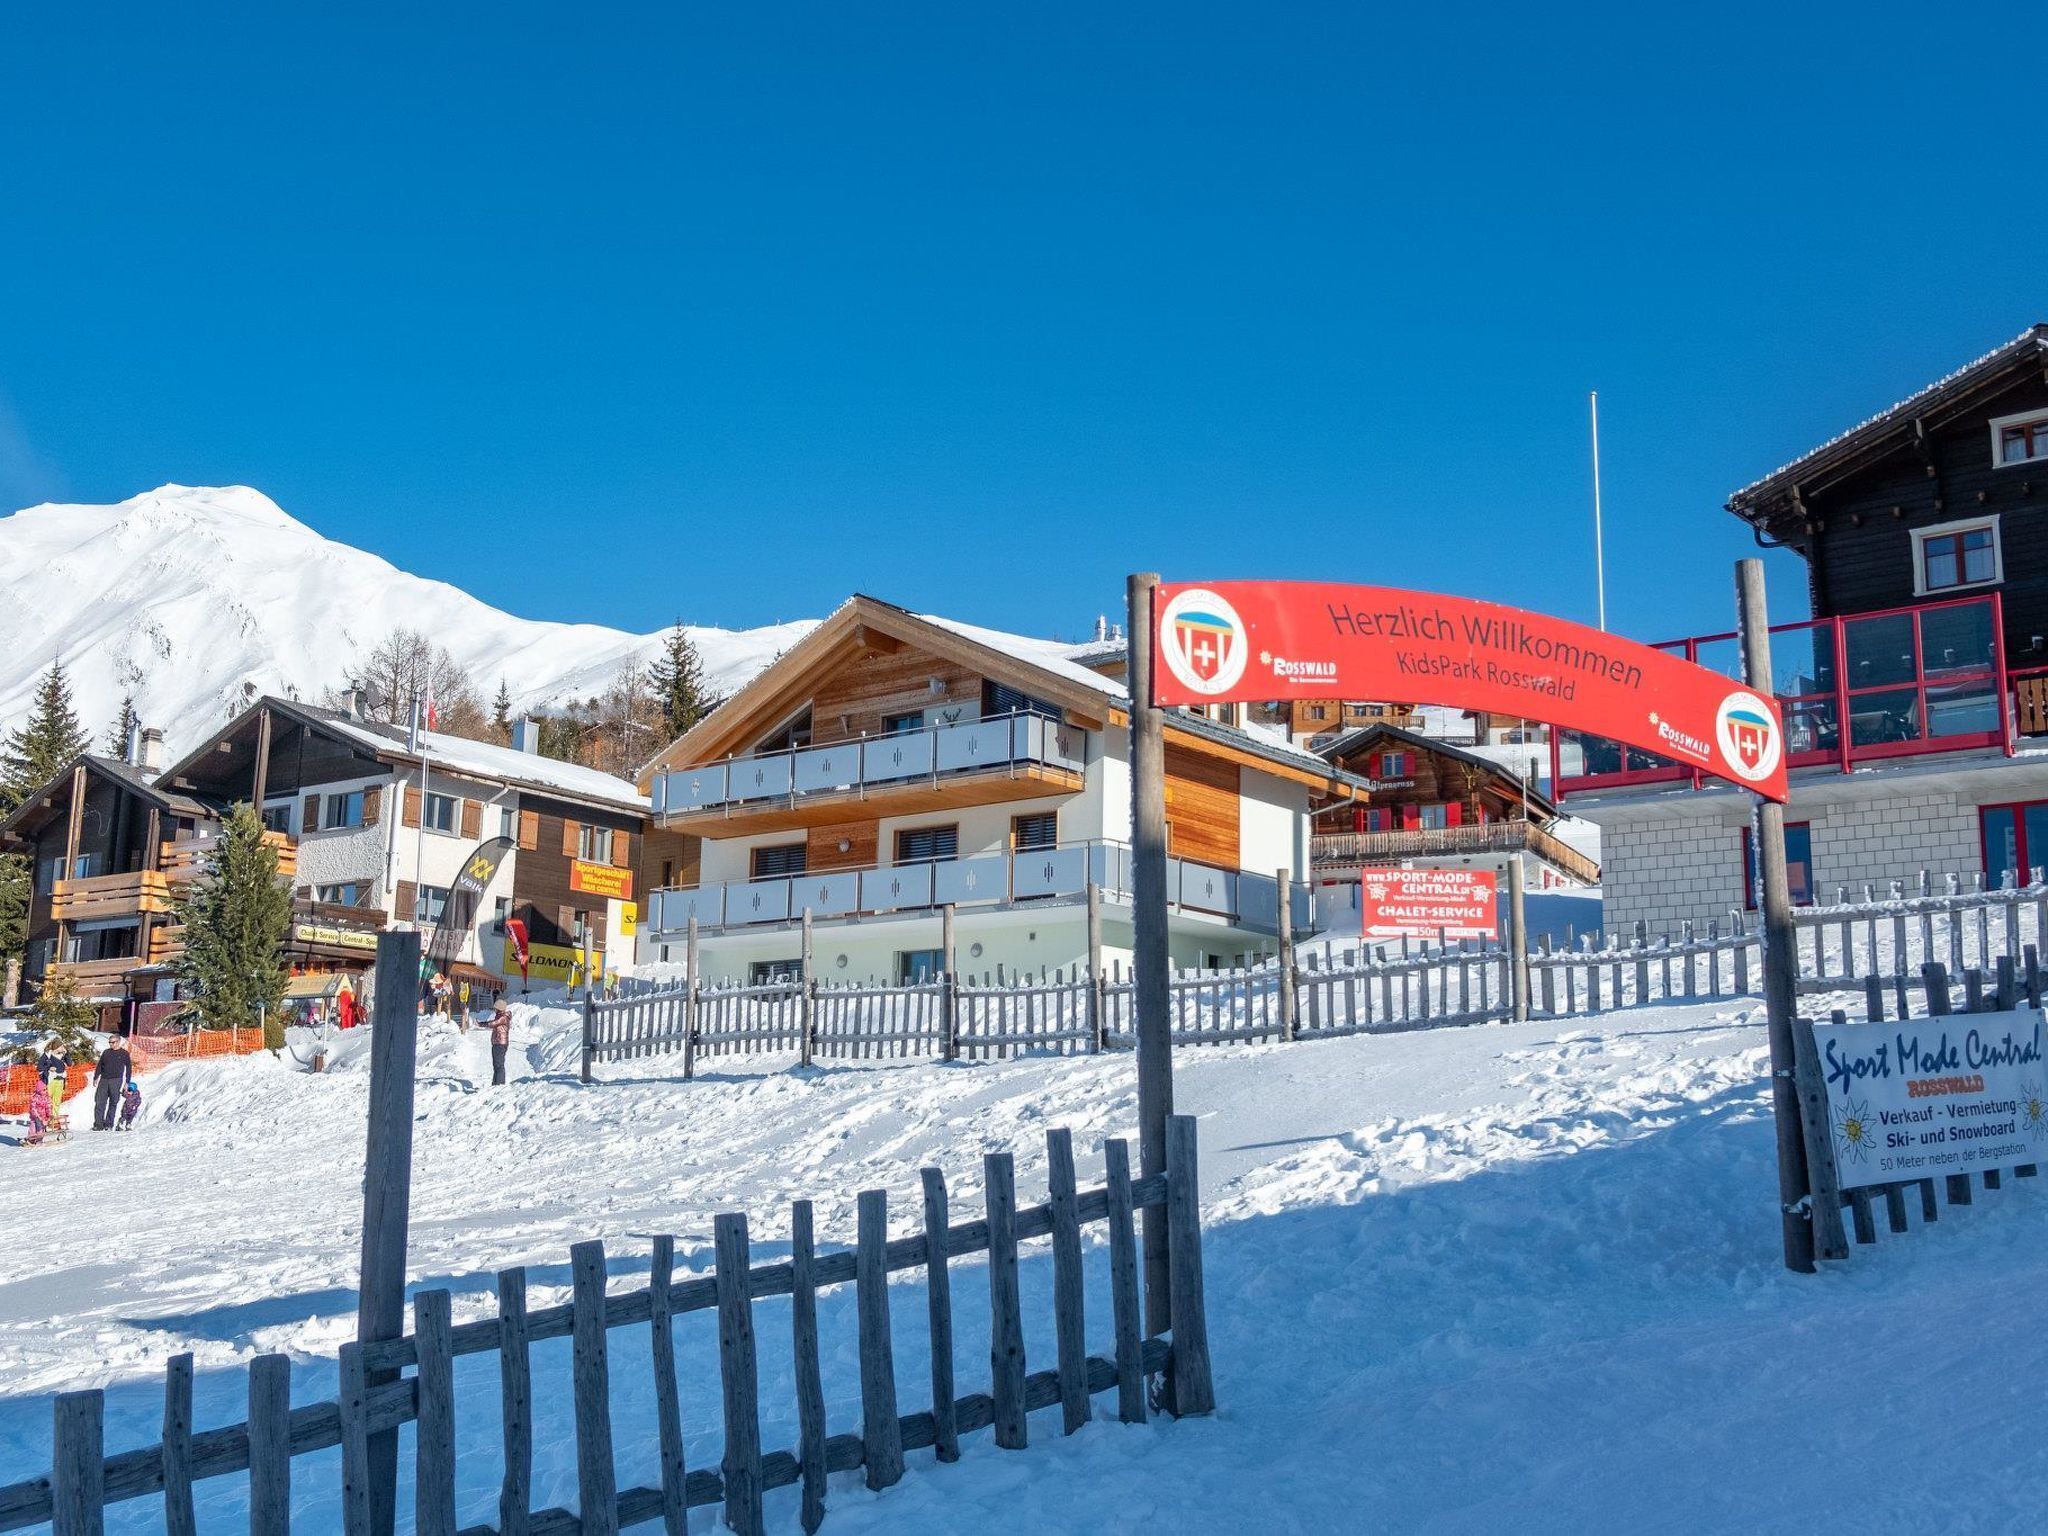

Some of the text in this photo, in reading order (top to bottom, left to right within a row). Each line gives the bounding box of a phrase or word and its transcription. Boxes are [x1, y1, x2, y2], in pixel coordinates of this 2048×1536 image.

[1327, 604, 1642, 690] Herzlich Willkommen
[1273, 657, 1337, 676] ROSSWALD
[1397, 651, 1576, 701] KidsPark Rosswald
[1658, 721, 1710, 755] ROSSWALD
[1376, 905, 1484, 918] CHALET-SERVICE
[509, 952, 579, 969] SLOMON
[1825, 1023, 2042, 1095] Sport Mode Central
[1907, 1074, 1985, 1098] ROSSWALD
[1880, 1106, 1934, 1125] Verkauf
[1946, 1099, 2017, 1119] Vermietung
[1887, 1119, 2016, 1148] Ski- und Snowboard
[1880, 1142, 2027, 1171] 50 Meter neben der Bergstation
